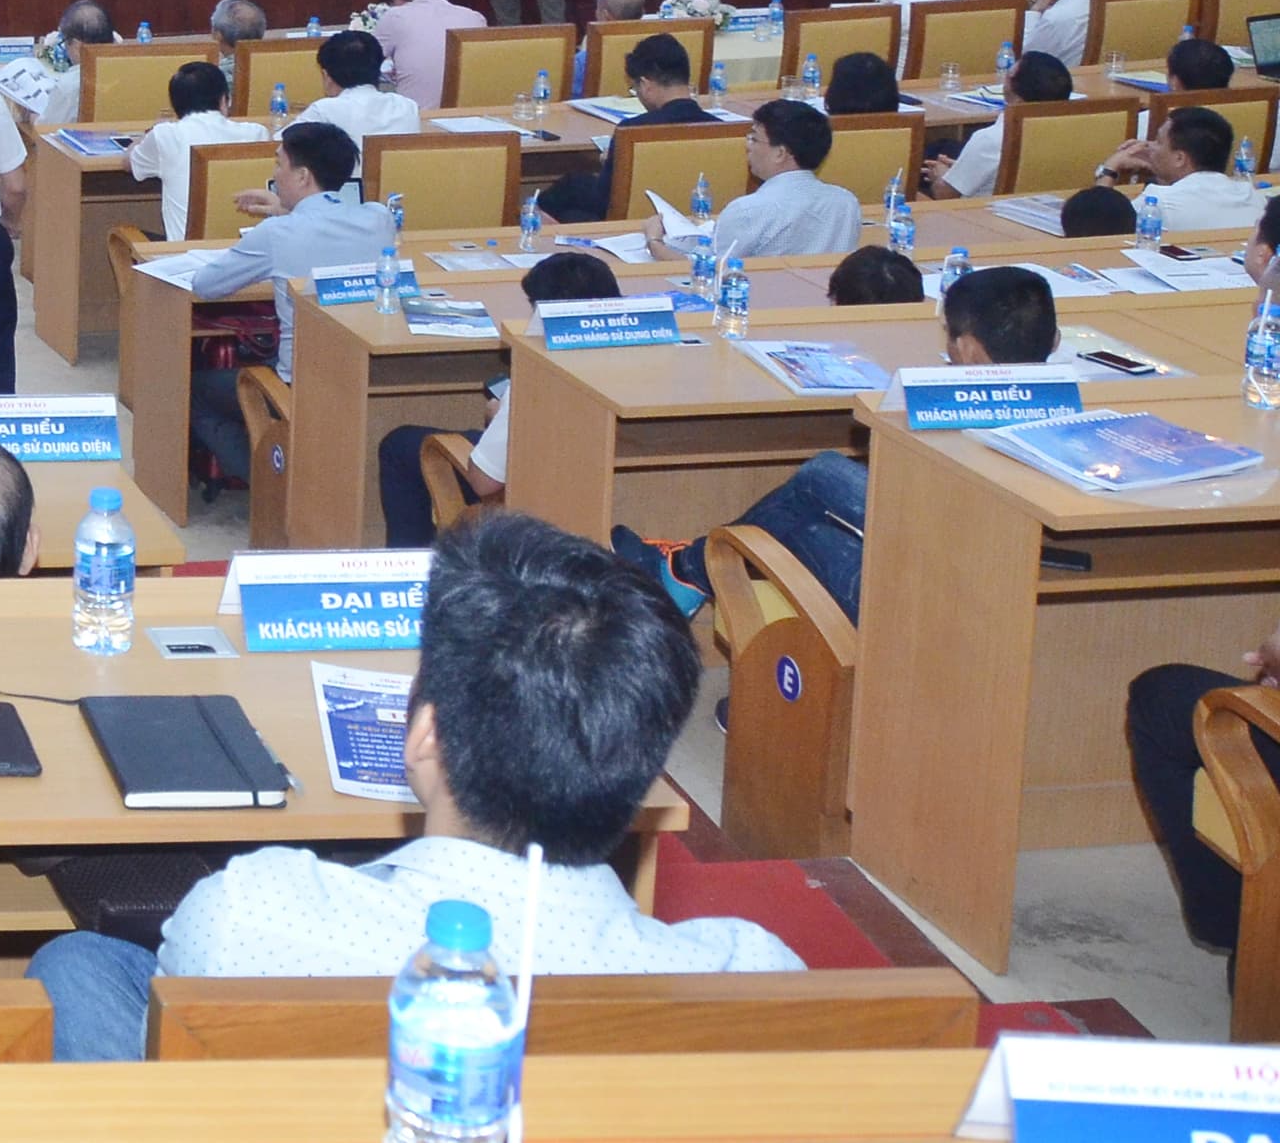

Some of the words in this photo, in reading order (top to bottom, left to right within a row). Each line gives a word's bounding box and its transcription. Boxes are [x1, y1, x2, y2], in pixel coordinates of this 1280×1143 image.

[955, 390, 987, 404] ĐẠI
[992, 384, 1032, 401] BIỂU
[22, 417, 65, 435] BIỂU
[43, 441, 80, 457] DỤNG
[321, 592, 372, 614] ĐẠI
[380, 583, 424, 608] BIỂ
[259, 618, 322, 640] KHÁCH
[327, 617, 380, 638] HÀNG
[384, 614, 410, 637] SỬ
[784, 664, 794, 694] E
